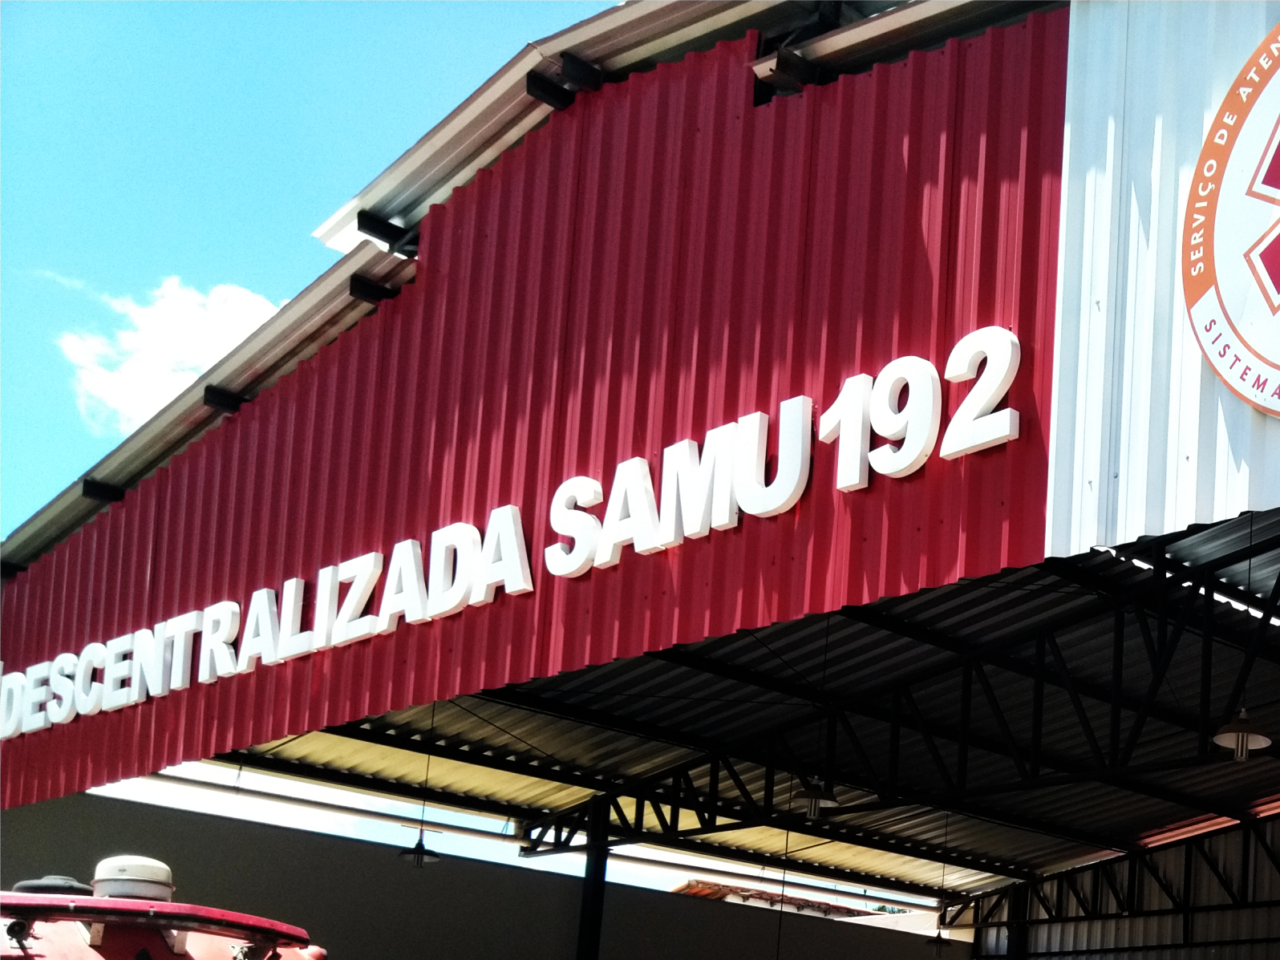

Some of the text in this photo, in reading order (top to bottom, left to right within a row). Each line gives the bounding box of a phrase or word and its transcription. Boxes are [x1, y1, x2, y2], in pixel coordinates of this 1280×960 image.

[1190, 158, 1217, 277] SERVIÇO
[1213, 110, 1238, 146] DE
[0, 325, 1021, 740] DESCENTRALIZADA SAMU 192
